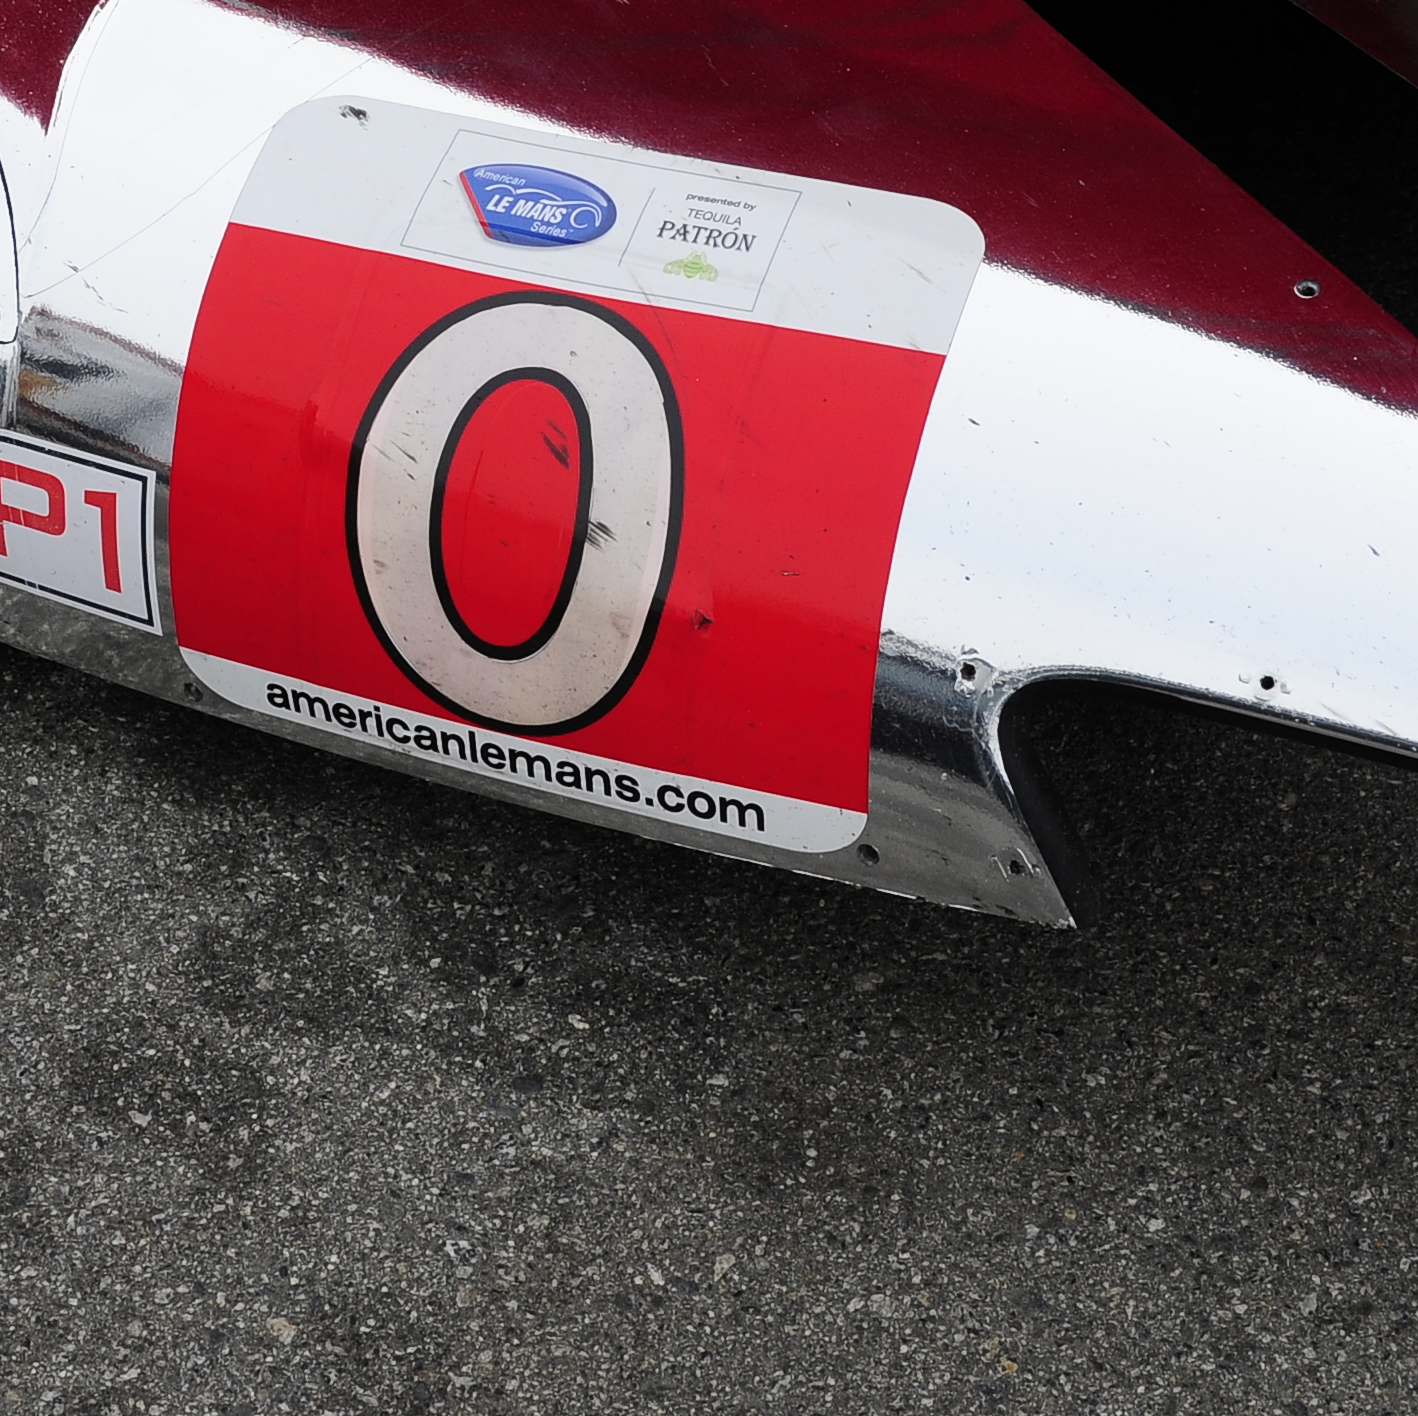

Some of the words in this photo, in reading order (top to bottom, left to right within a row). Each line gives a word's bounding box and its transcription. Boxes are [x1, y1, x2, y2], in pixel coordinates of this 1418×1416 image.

[473, 168, 526, 186] American
[485, 194, 514, 213] LE
[510, 199, 567, 224] MANS
[685, 193, 741, 208] presented
[743, 201, 757, 212] by
[530, 221, 568, 237] Series
[687, 208, 742, 226] TEQUILA
[656, 220, 757, 252] PATRÓN
[344, 289, 686, 738] 0
[265, 679, 767, 833] americanlemans.com
